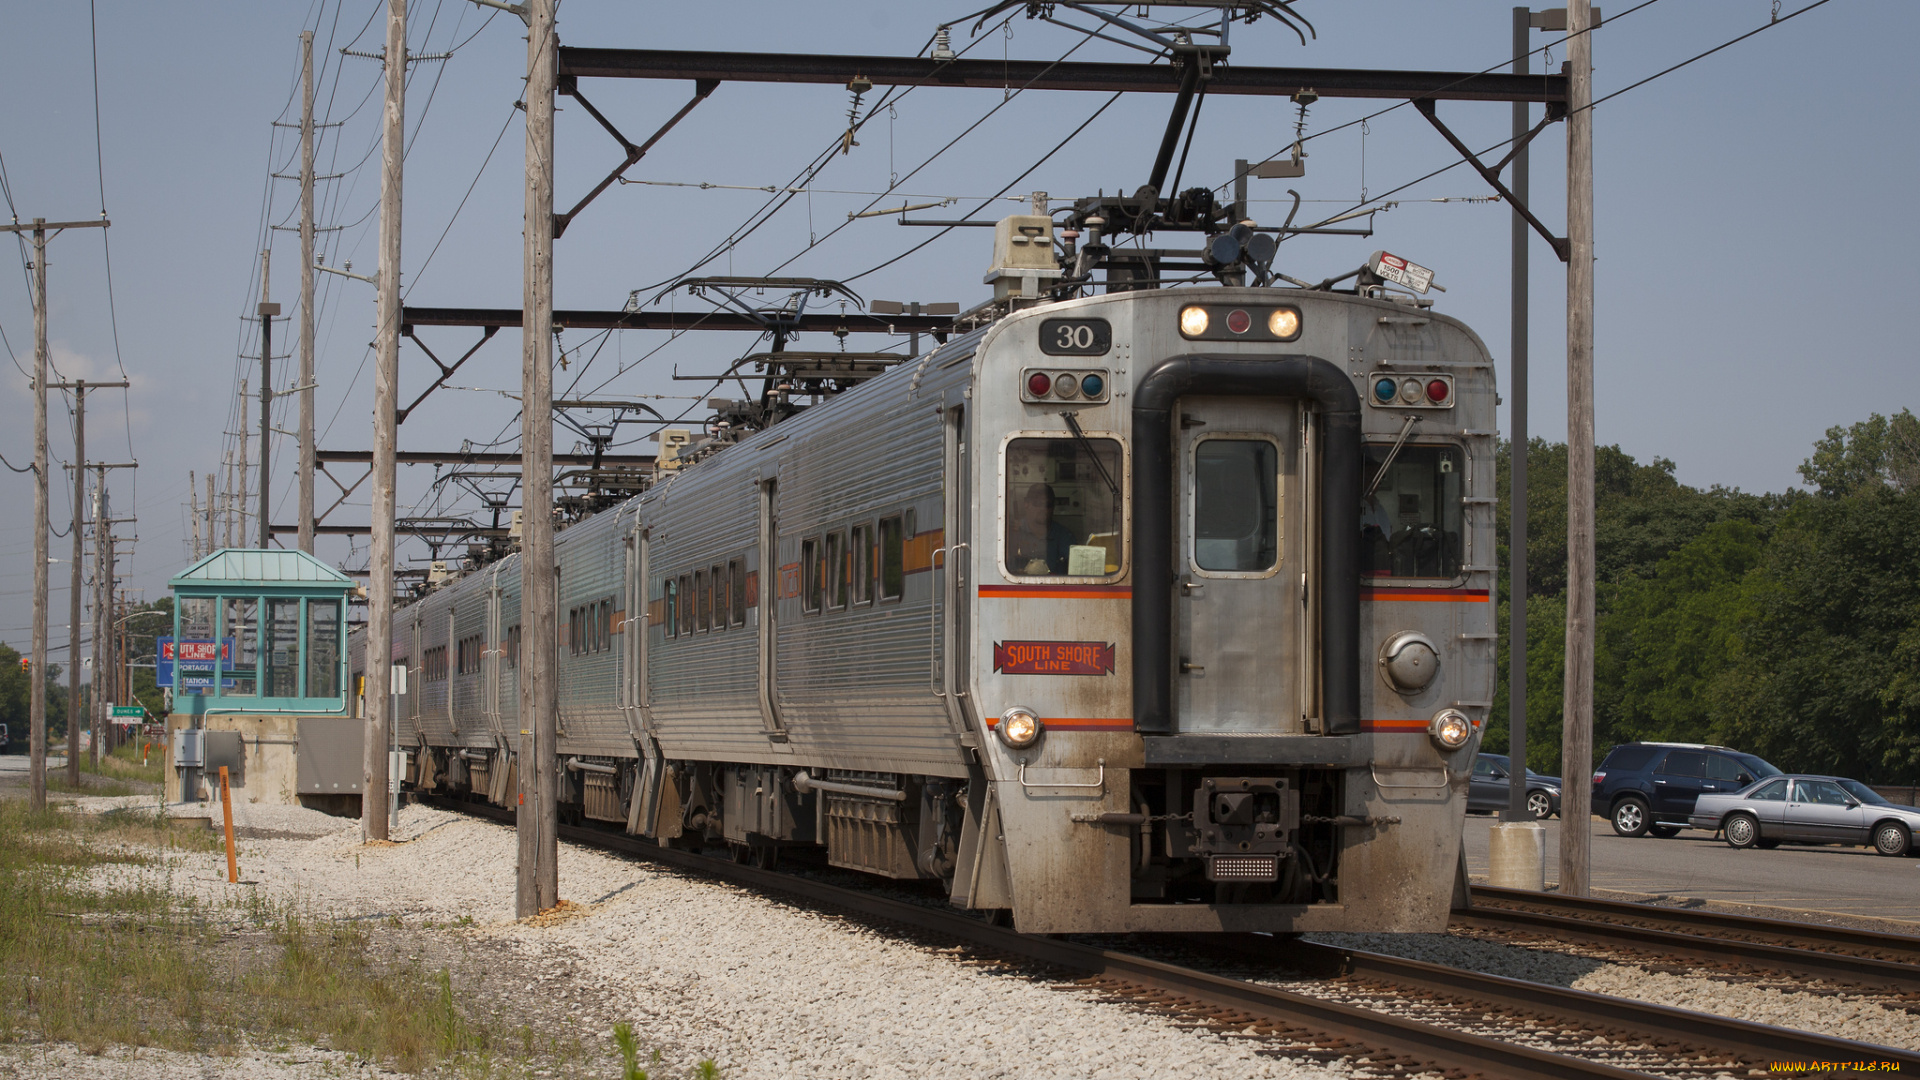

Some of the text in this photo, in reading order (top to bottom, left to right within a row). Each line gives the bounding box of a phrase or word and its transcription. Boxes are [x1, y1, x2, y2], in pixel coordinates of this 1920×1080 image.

[1380, 269, 1399, 281] VOLTS
[1383, 264, 1400, 276] 1500
[1057, 325, 1094, 349] 30
[169, 644, 218, 657] SUTH SHOR
[1007, 645, 1101, 670] SOUTH SHORE
[1035, 660, 1071, 671] LINE
